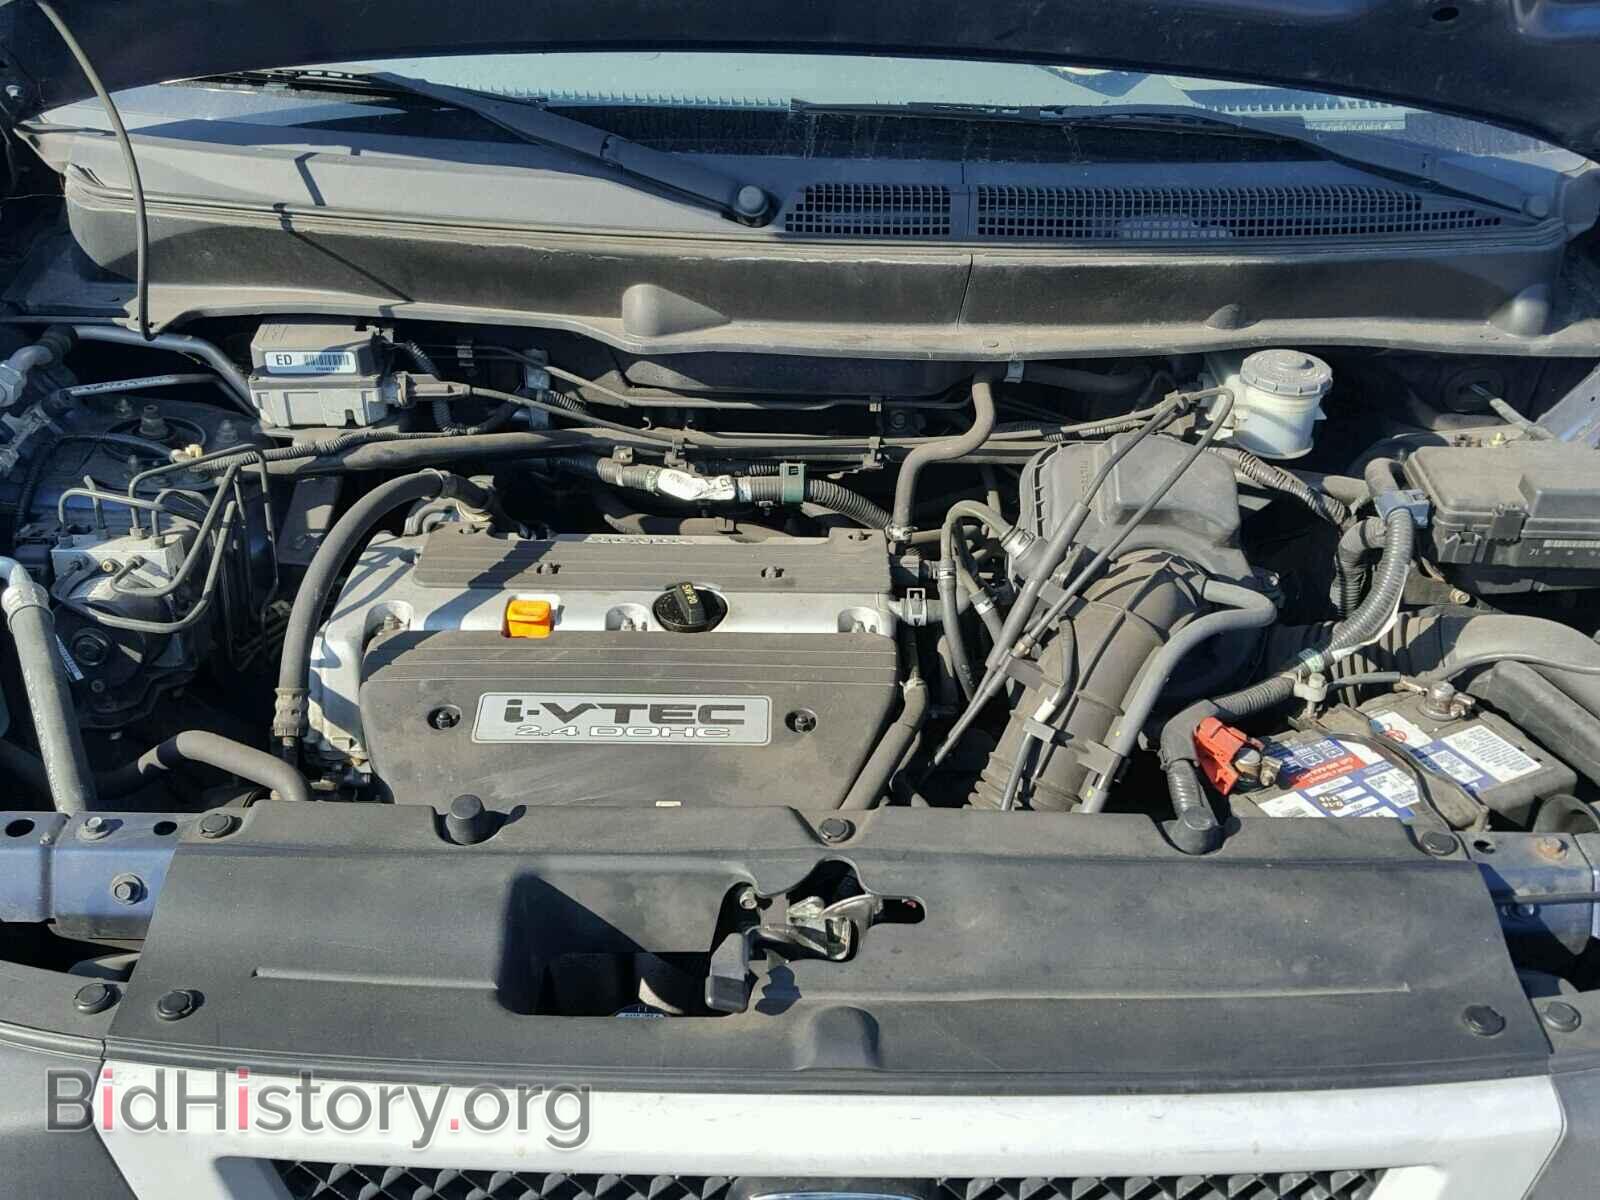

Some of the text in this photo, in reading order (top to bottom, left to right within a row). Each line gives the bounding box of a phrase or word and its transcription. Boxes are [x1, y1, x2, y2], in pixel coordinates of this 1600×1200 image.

[275, 354, 293, 366] ED
[504, 699, 746, 725] i-VTEC
[515, 725, 731, 739] 2.4 DOHC
